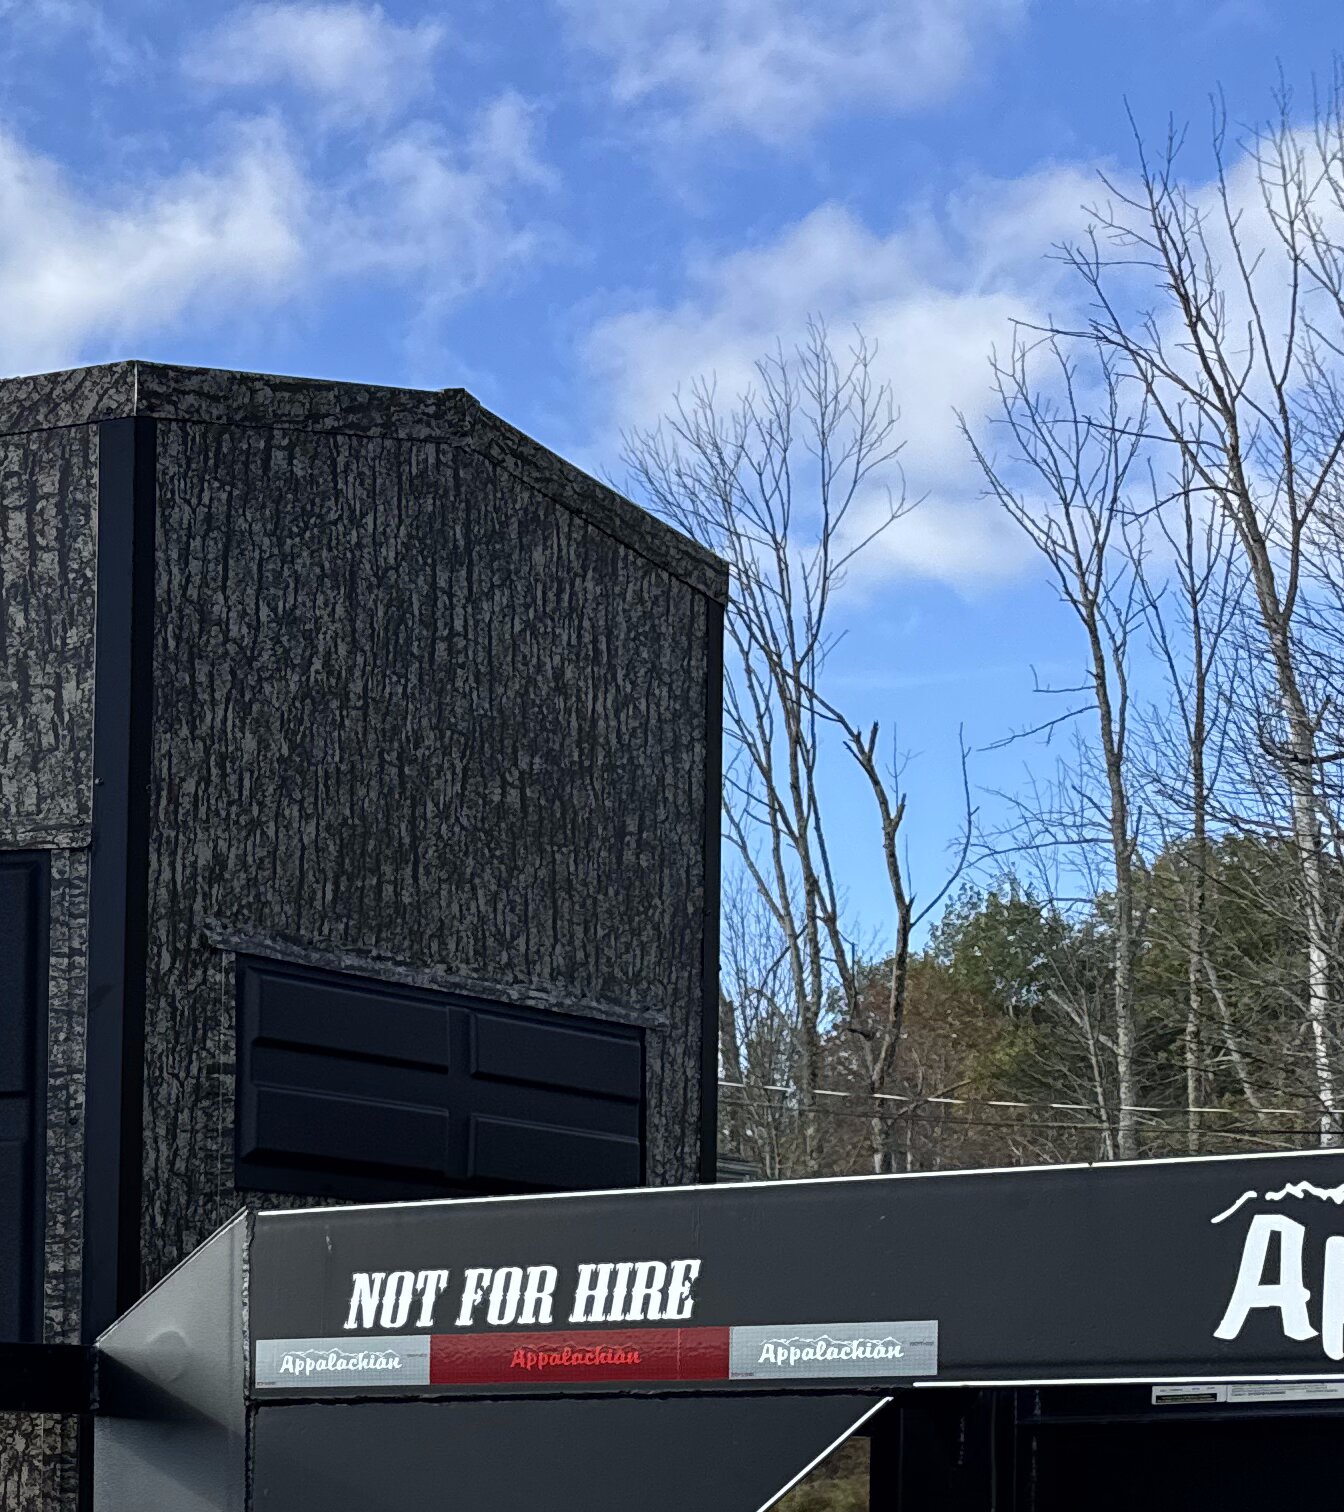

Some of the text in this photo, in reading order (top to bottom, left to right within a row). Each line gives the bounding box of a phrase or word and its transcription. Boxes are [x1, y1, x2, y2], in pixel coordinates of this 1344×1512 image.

[343, 1258, 701, 1329] NOT FOR HIRE
[279, 1352, 402, 1376] Appalachian
[510, 1347, 641, 1371] Appalachian
[758, 1340, 905, 1366] Appalachian
